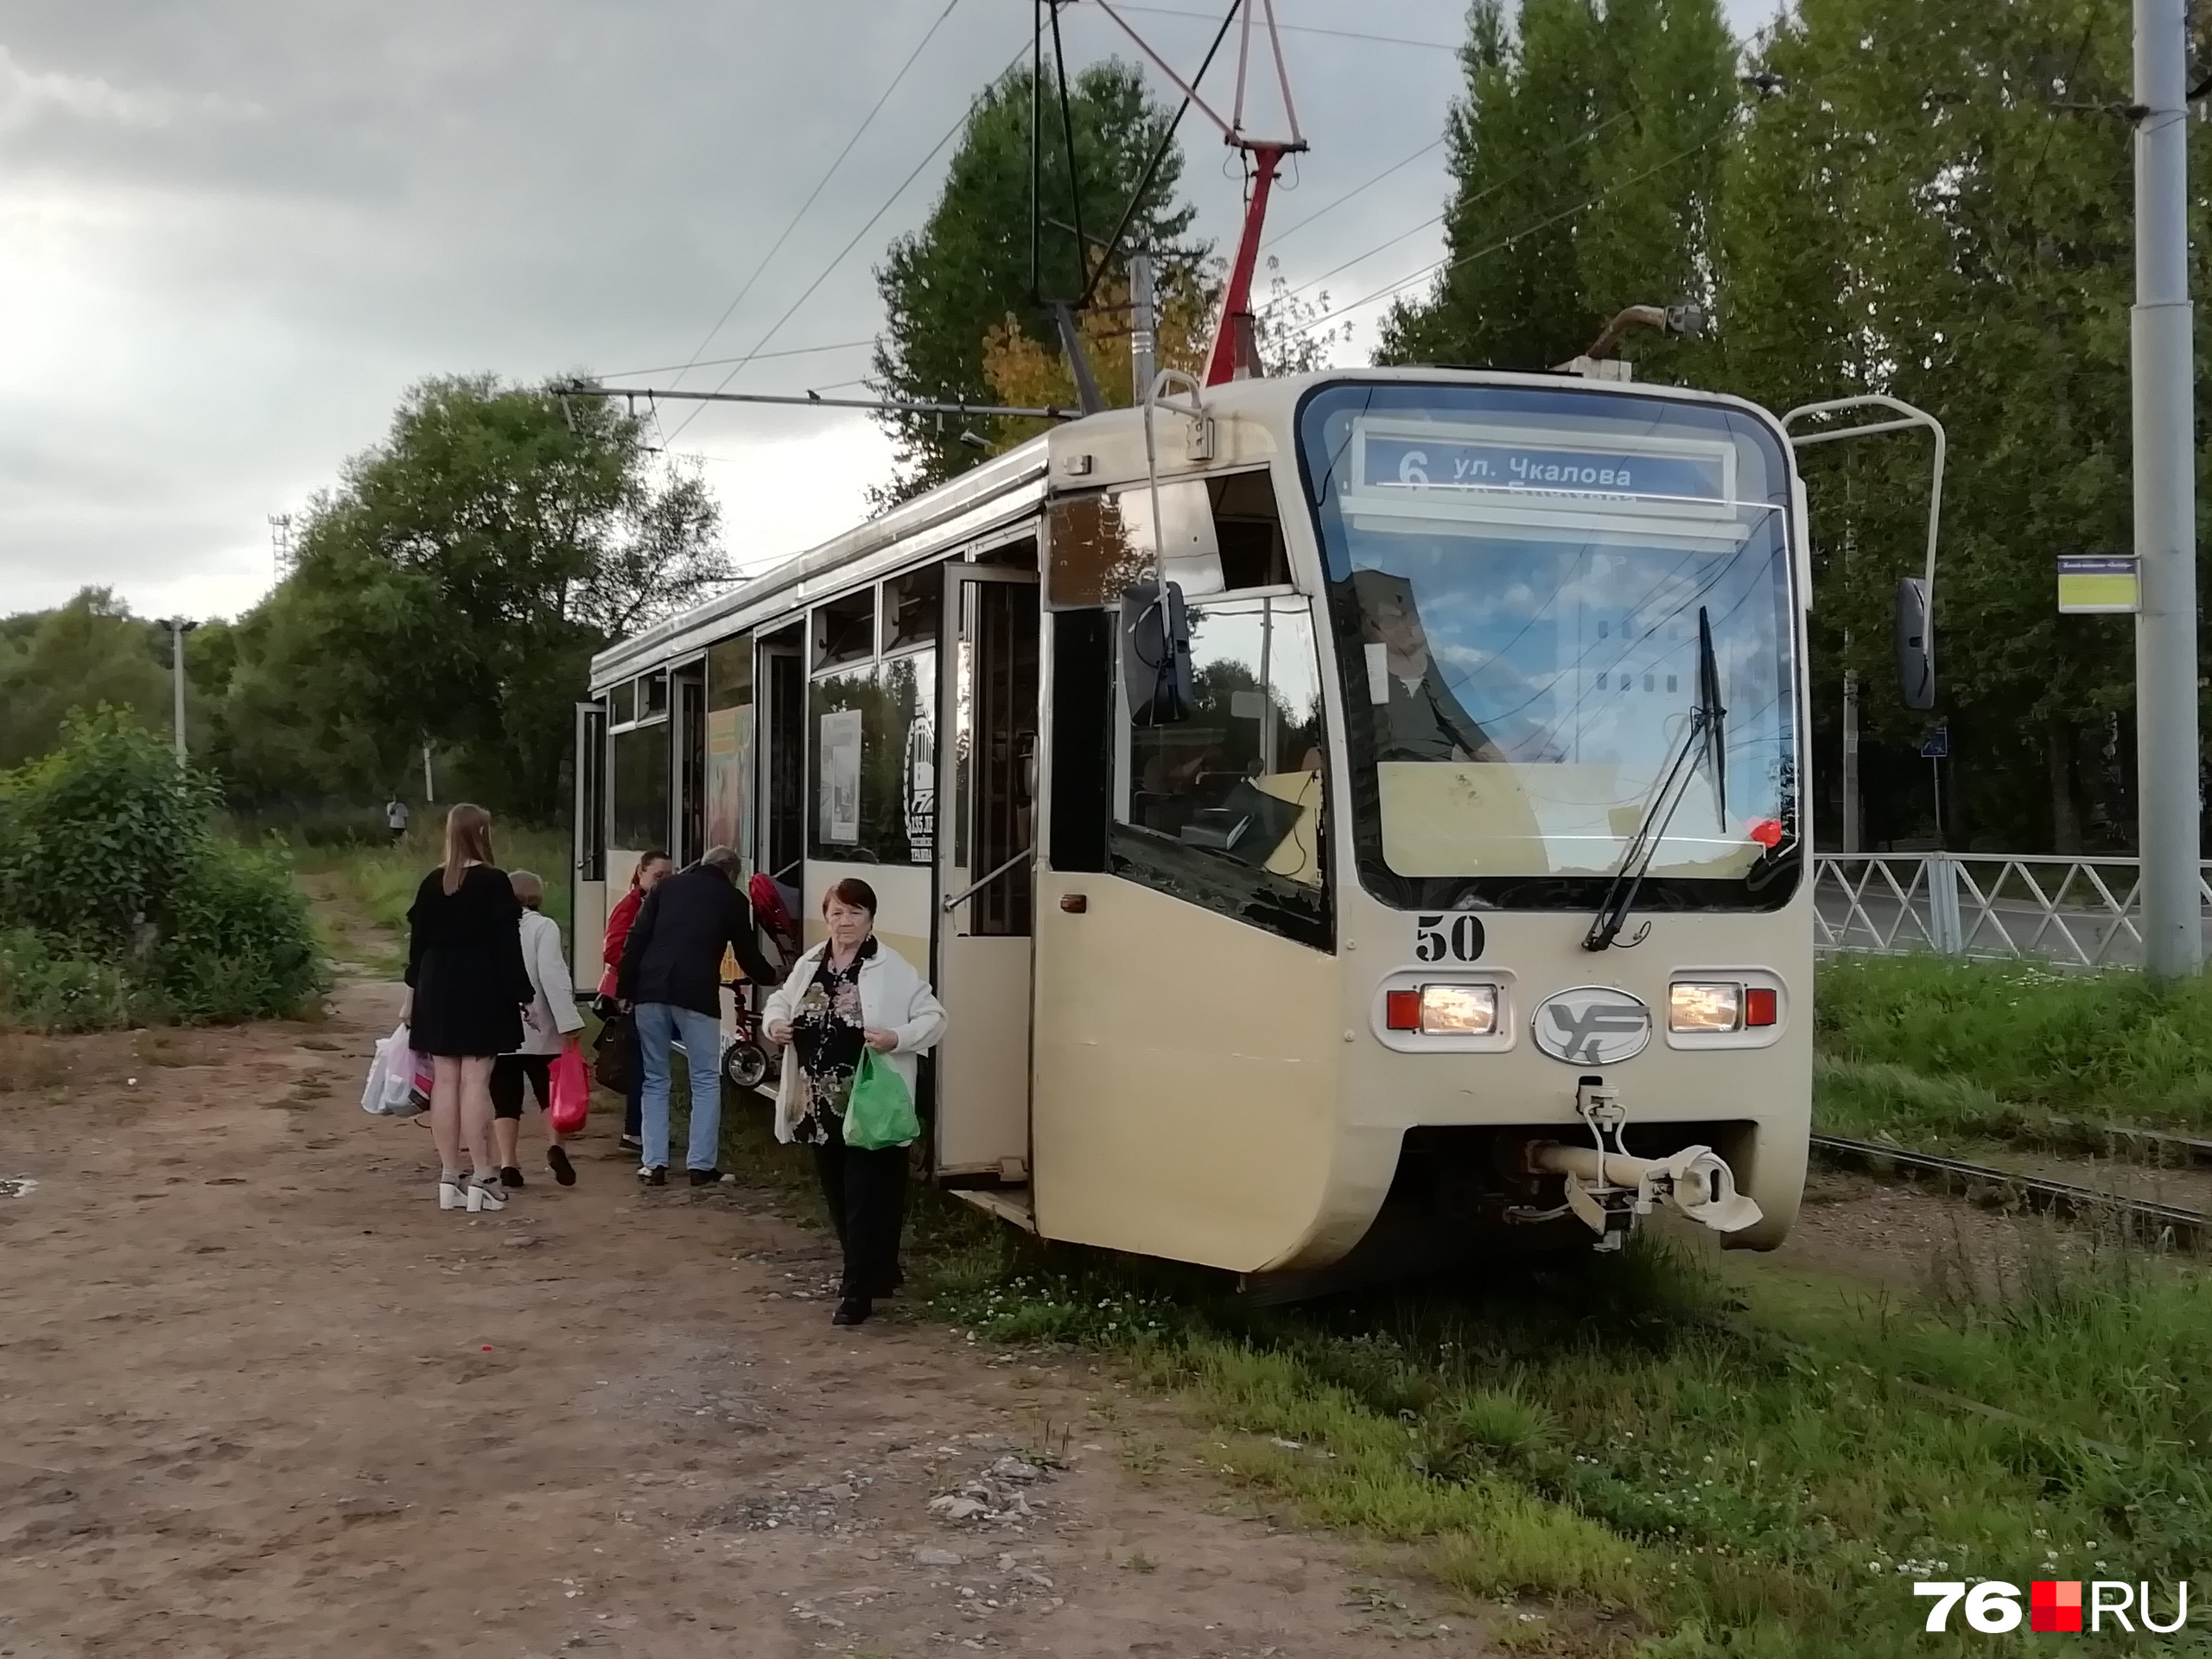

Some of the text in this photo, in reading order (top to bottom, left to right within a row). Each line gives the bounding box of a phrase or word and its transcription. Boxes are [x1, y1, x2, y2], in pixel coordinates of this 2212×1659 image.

[1399, 450, 1430, 491] 6
[1453, 457, 1497, 480] ул.
[1510, 456, 1631, 486] Чкалова
[1415, 914, 1485, 963] 50
